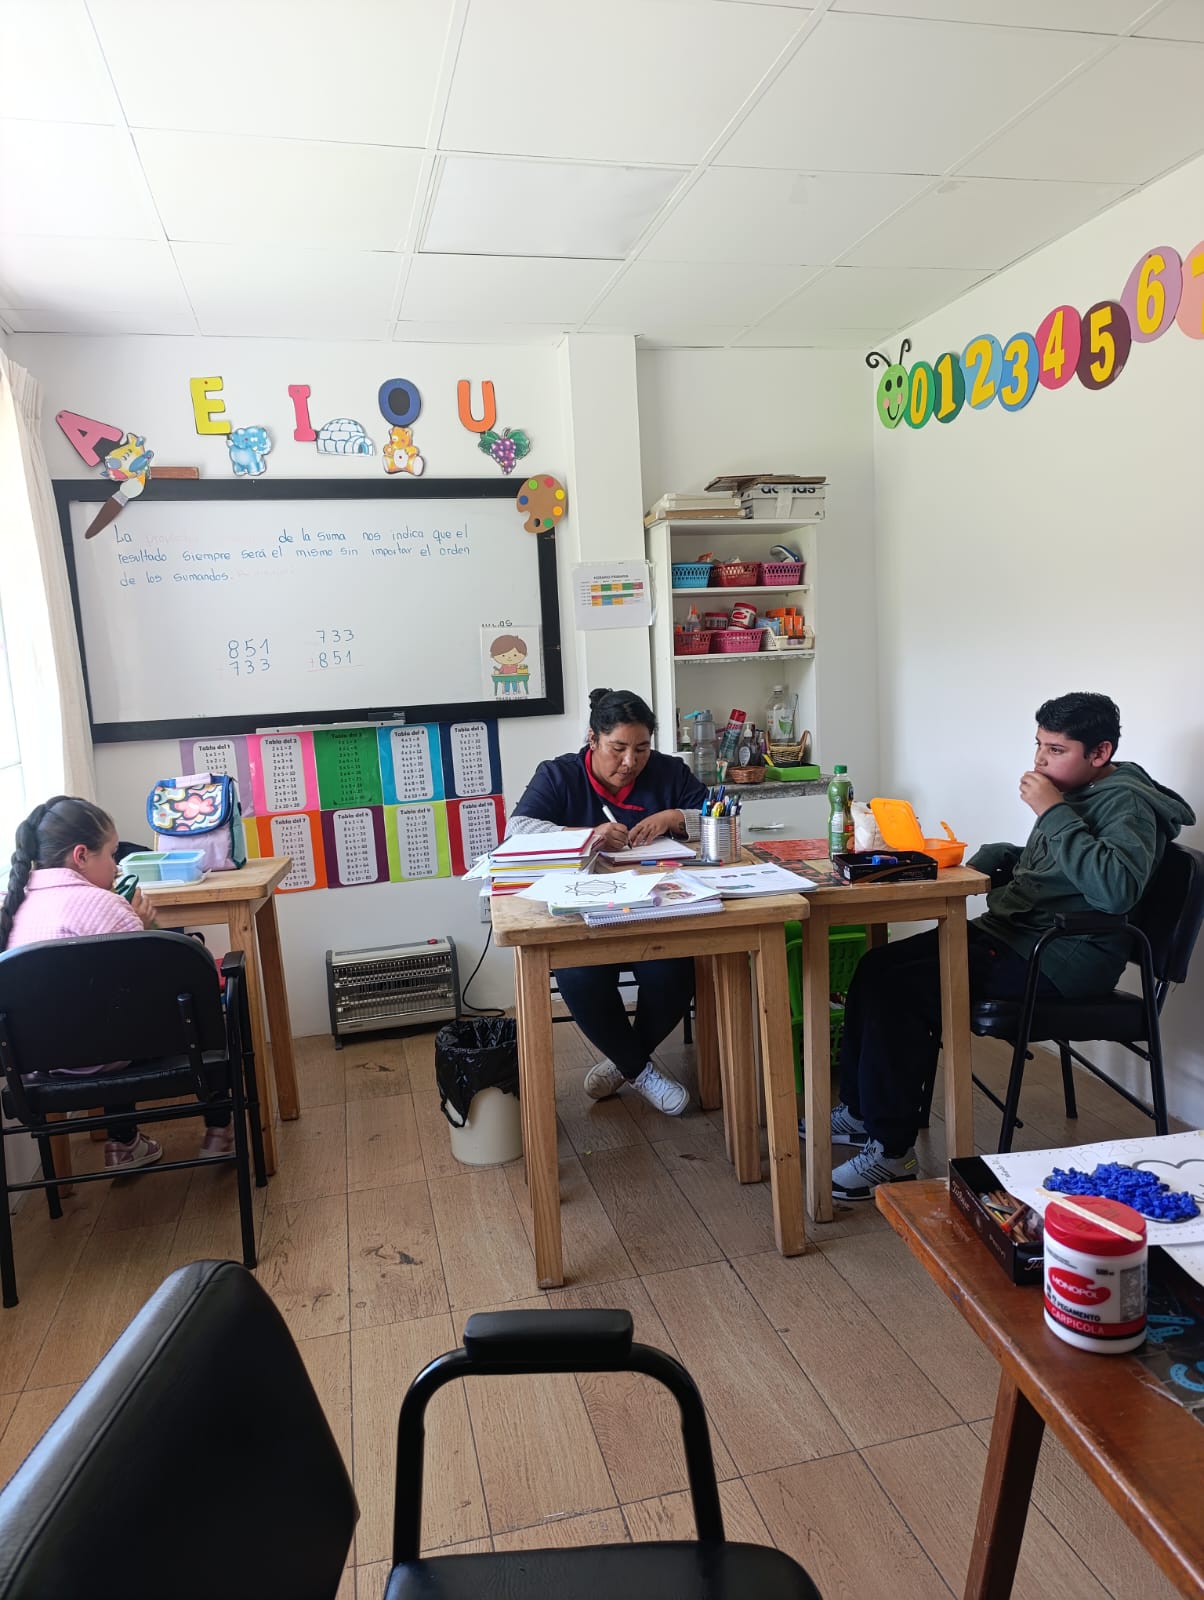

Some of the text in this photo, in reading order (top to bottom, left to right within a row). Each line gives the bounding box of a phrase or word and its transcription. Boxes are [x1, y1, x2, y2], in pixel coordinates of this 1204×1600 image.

[910, 367, 928, 424] 0
[937, 354, 956, 419] 1
[965, 339, 995, 408] 2
[1002, 338, 1029, 406] 3
[1043, 310, 1064, 380] 4
[1090, 306, 1115, 382] 5
[1137, 254, 1166, 335] 6
[56, 376, 496, 467] A E I O U
[114, 524, 132, 543] La
[279, 523, 467, 544] de la suma nos indica que el
[118, 548, 167, 564] resultado
[271, 545, 282, 558] el
[296, 548, 333, 557] mismo
[340, 547, 358, 556] sin
[372, 542, 412, 557] importar
[420, 544, 430, 556] el
[440, 544, 469, 555] orden
[120, 571, 136, 586] de
[146, 571, 162, 583] los
[316, 629, 354, 643] 733
[228, 638, 270, 659] 851
[319, 650, 352, 668] 851
[229, 659, 270, 676] 733
[1052, 1274, 1098, 1299] MONOPOL
[1051, 1308, 1104, 1334] CARPICOLA
[1057, 1302, 1101, 1322] PEGAMENTO
